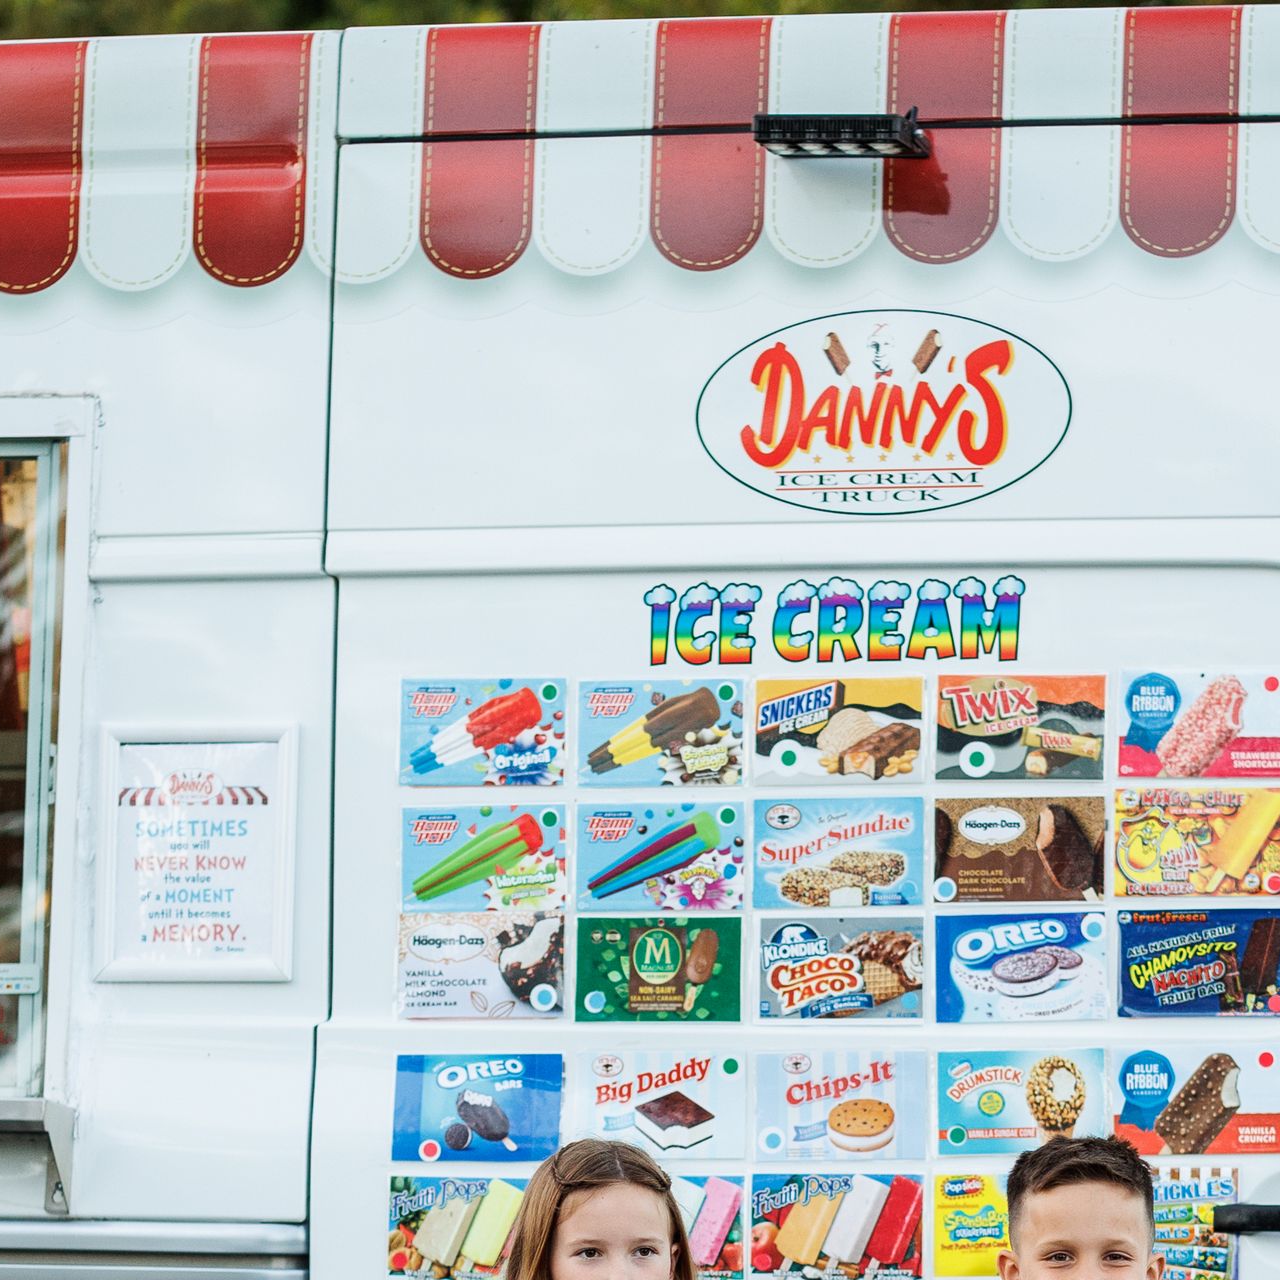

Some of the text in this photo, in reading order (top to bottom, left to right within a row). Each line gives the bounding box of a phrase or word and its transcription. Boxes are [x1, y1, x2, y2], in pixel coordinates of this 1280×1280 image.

[740, 340, 1014, 468] DANNY'S
[778, 471, 983, 488] ICE CREAM
[812, 490, 942, 503] TRUCK
[644, 575, 1026, 666] ICE CREAM
[1140, 686, 1166, 696] BLUE
[760, 685, 833, 728] SNICKERS
[1132, 695, 1174, 713] RIBBON
[779, 719, 796, 734] ICE
[985, 716, 1040, 733] ICE CREAM
[135, 820, 249, 838] SOMETIMES
[192, 840, 210, 851] will
[761, 813, 910, 865] Super Sundae
[134, 855, 248, 873] NEVER KNOW
[958, 869, 1003, 877] CHOCOLATE
[164, 873, 212, 884] the value
[140, 891, 152, 901] of
[165, 888, 235, 904] MOMENT
[148, 908, 231, 919] until it becomes
[141, 924, 247, 943] a MEMORY.
[955, 919, 1065, 961] OREO
[1127, 923, 1237, 958] ALL NATURAL FRUIT
[762, 937, 828, 968] KLONDIKE
[771, 957, 854, 989] CHOCO
[1152, 960, 1226, 995] NACHITO
[405, 979, 487, 988] MILK CHOCOLATE
[781, 978, 846, 1009] TACO
[1160, 983, 1226, 1006] FRUIT BAR
[437, 1059, 524, 1089] OREO
[1134, 1064, 1159, 1073] BLUE
[595, 1056, 712, 1105] Big Daddy
[786, 1060, 893, 1105] Chips-It
[948, 1067, 1022, 1101] DRUMSTICK
[1126, 1073, 1168, 1090] RIBBON
[968, 1129, 994, 1139] VANILLA
[995, 1128, 1018, 1138] SUNDAE
[1238, 1126, 1276, 1135] VANILLA
[1238, 1135, 1276, 1143] CRUNCH
[439, 1179, 488, 1209] Pops
[802, 1176, 852, 1206] Pops
